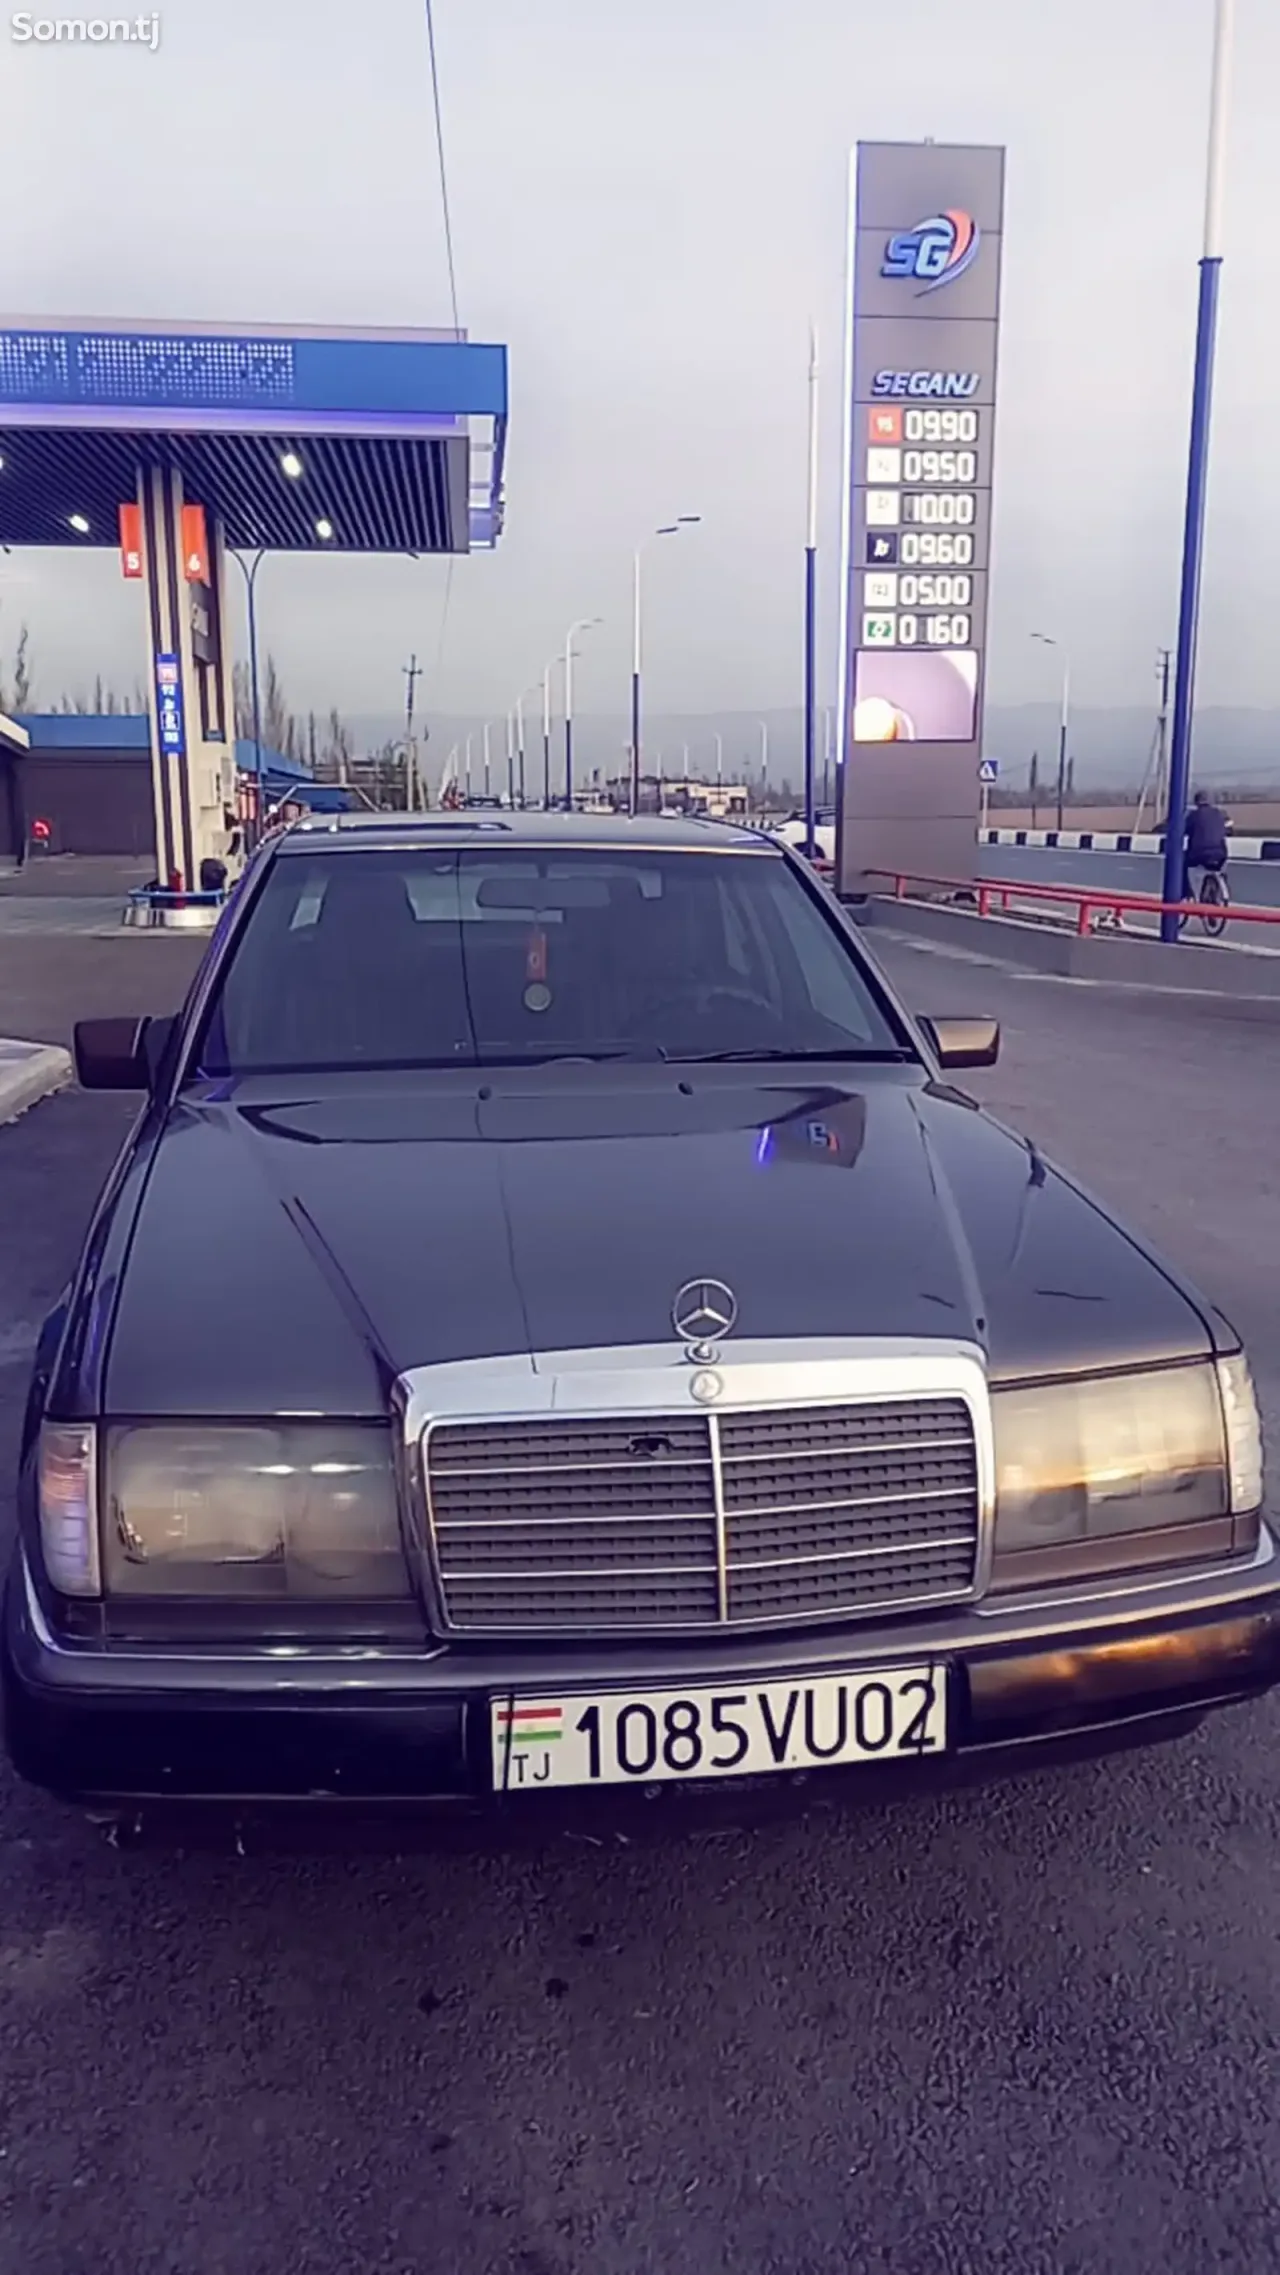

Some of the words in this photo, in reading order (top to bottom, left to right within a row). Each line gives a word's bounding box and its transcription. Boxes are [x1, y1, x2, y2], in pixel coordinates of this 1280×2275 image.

[881, 234, 951, 278] SG
[871, 369, 980, 398] SEGANJ
[905, 410, 977, 441] 0990
[903, 450, 975, 482] 0950
[912, 493, 974, 524] 1000
[127, 553, 139, 569] 5
[188, 554, 200, 571] 6
[901, 533, 973, 564] 0960
[900, 575, 970, 606] 0500
[576, 1679, 936, 1779] 1085VU02
[512, 1752, 550, 1782] TJ
